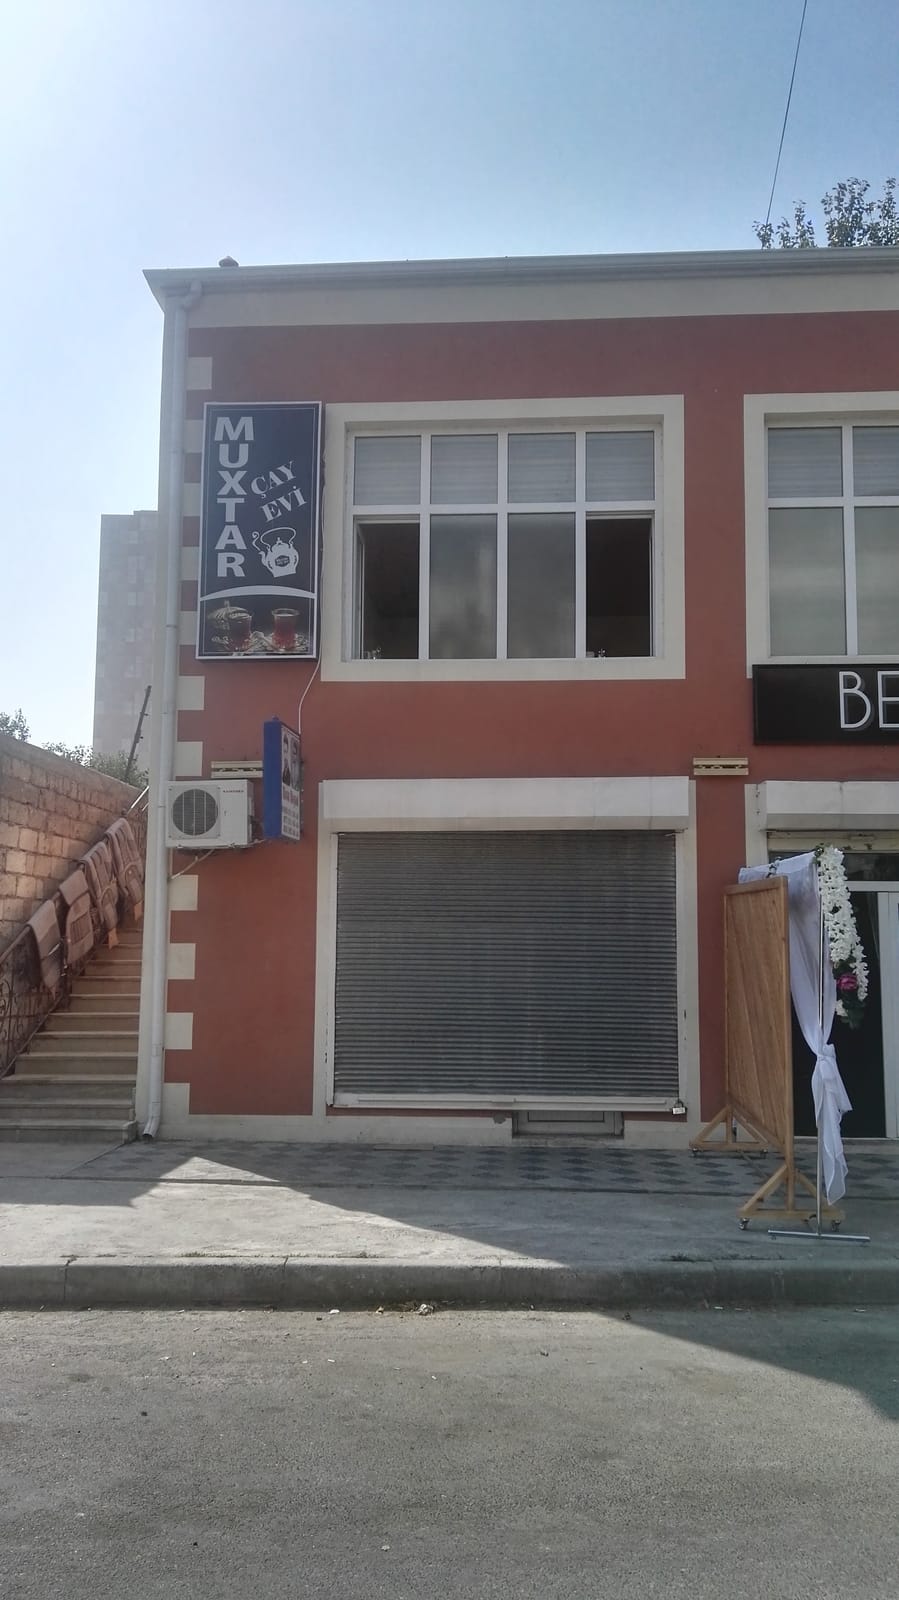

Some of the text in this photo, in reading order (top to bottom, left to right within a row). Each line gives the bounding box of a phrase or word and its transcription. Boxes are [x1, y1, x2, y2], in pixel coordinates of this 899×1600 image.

[214, 416, 254, 577] MUXTAR
[251, 461, 297, 498] ÇAY
[260, 485, 307, 522] EVİ
